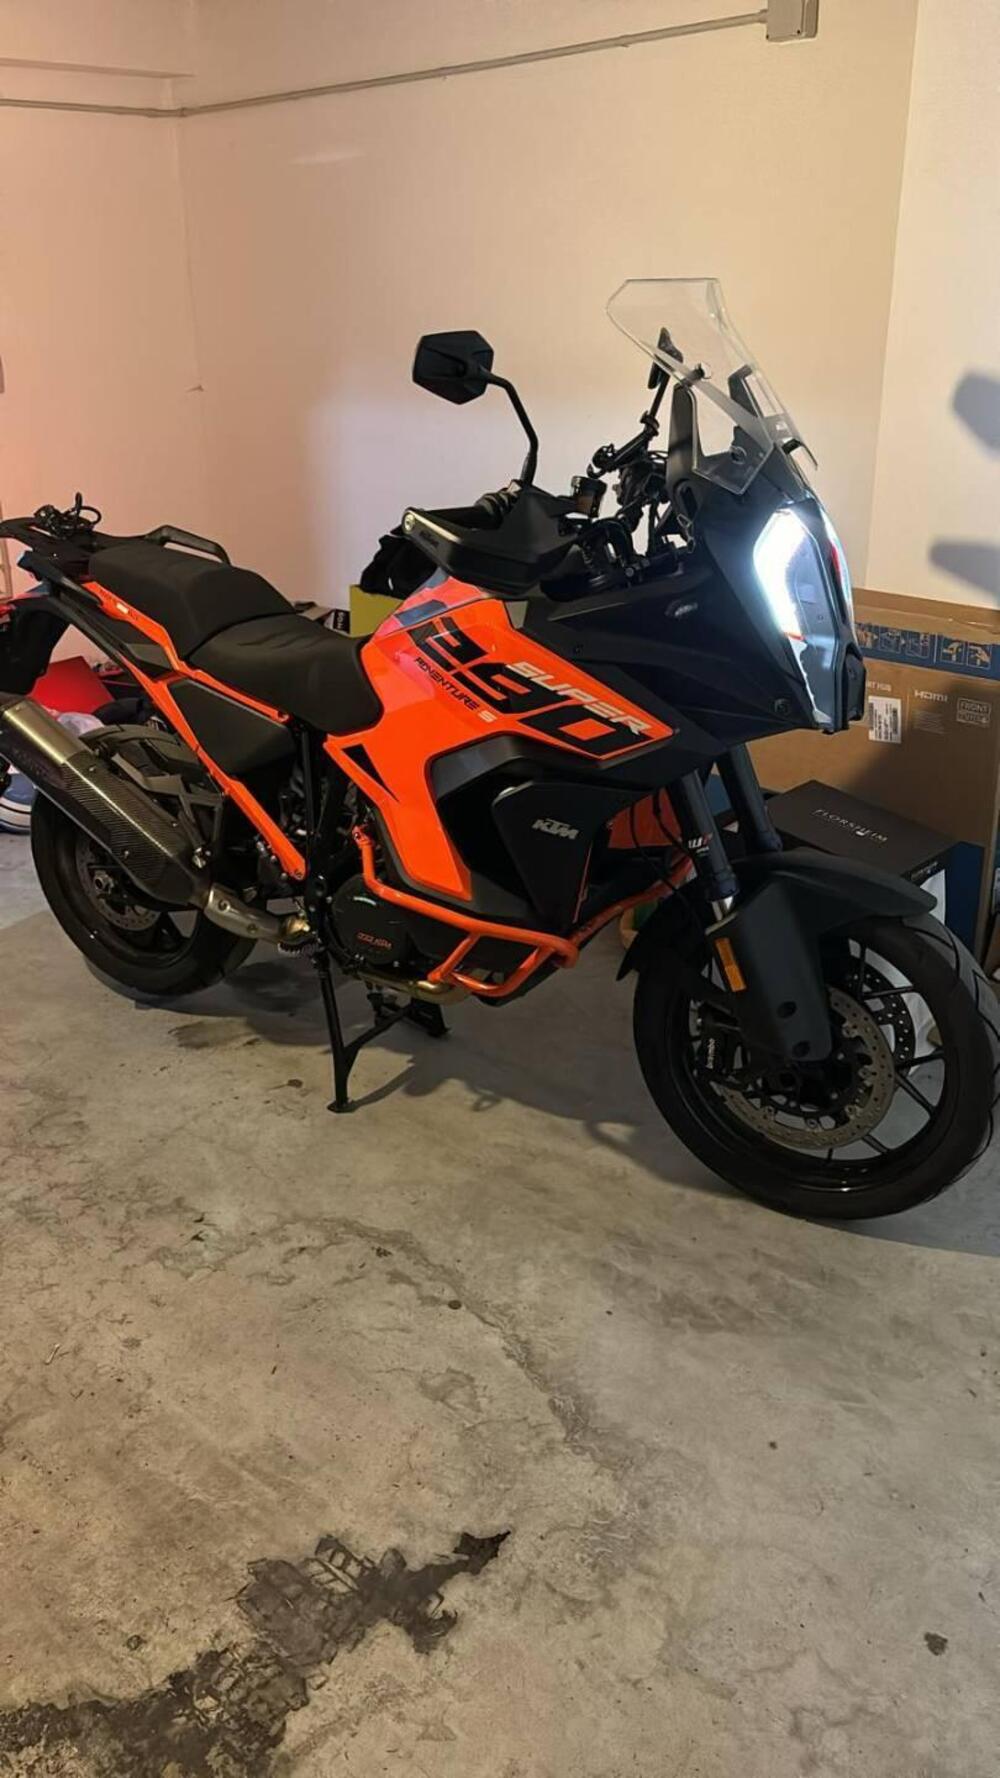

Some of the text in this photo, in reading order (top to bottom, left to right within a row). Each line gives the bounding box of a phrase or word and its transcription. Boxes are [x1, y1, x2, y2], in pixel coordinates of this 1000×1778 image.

[414, 656, 498, 723] ADVENTURE S
[505, 661, 652, 735] SUPER
[531, 818, 579, 839] KTM
